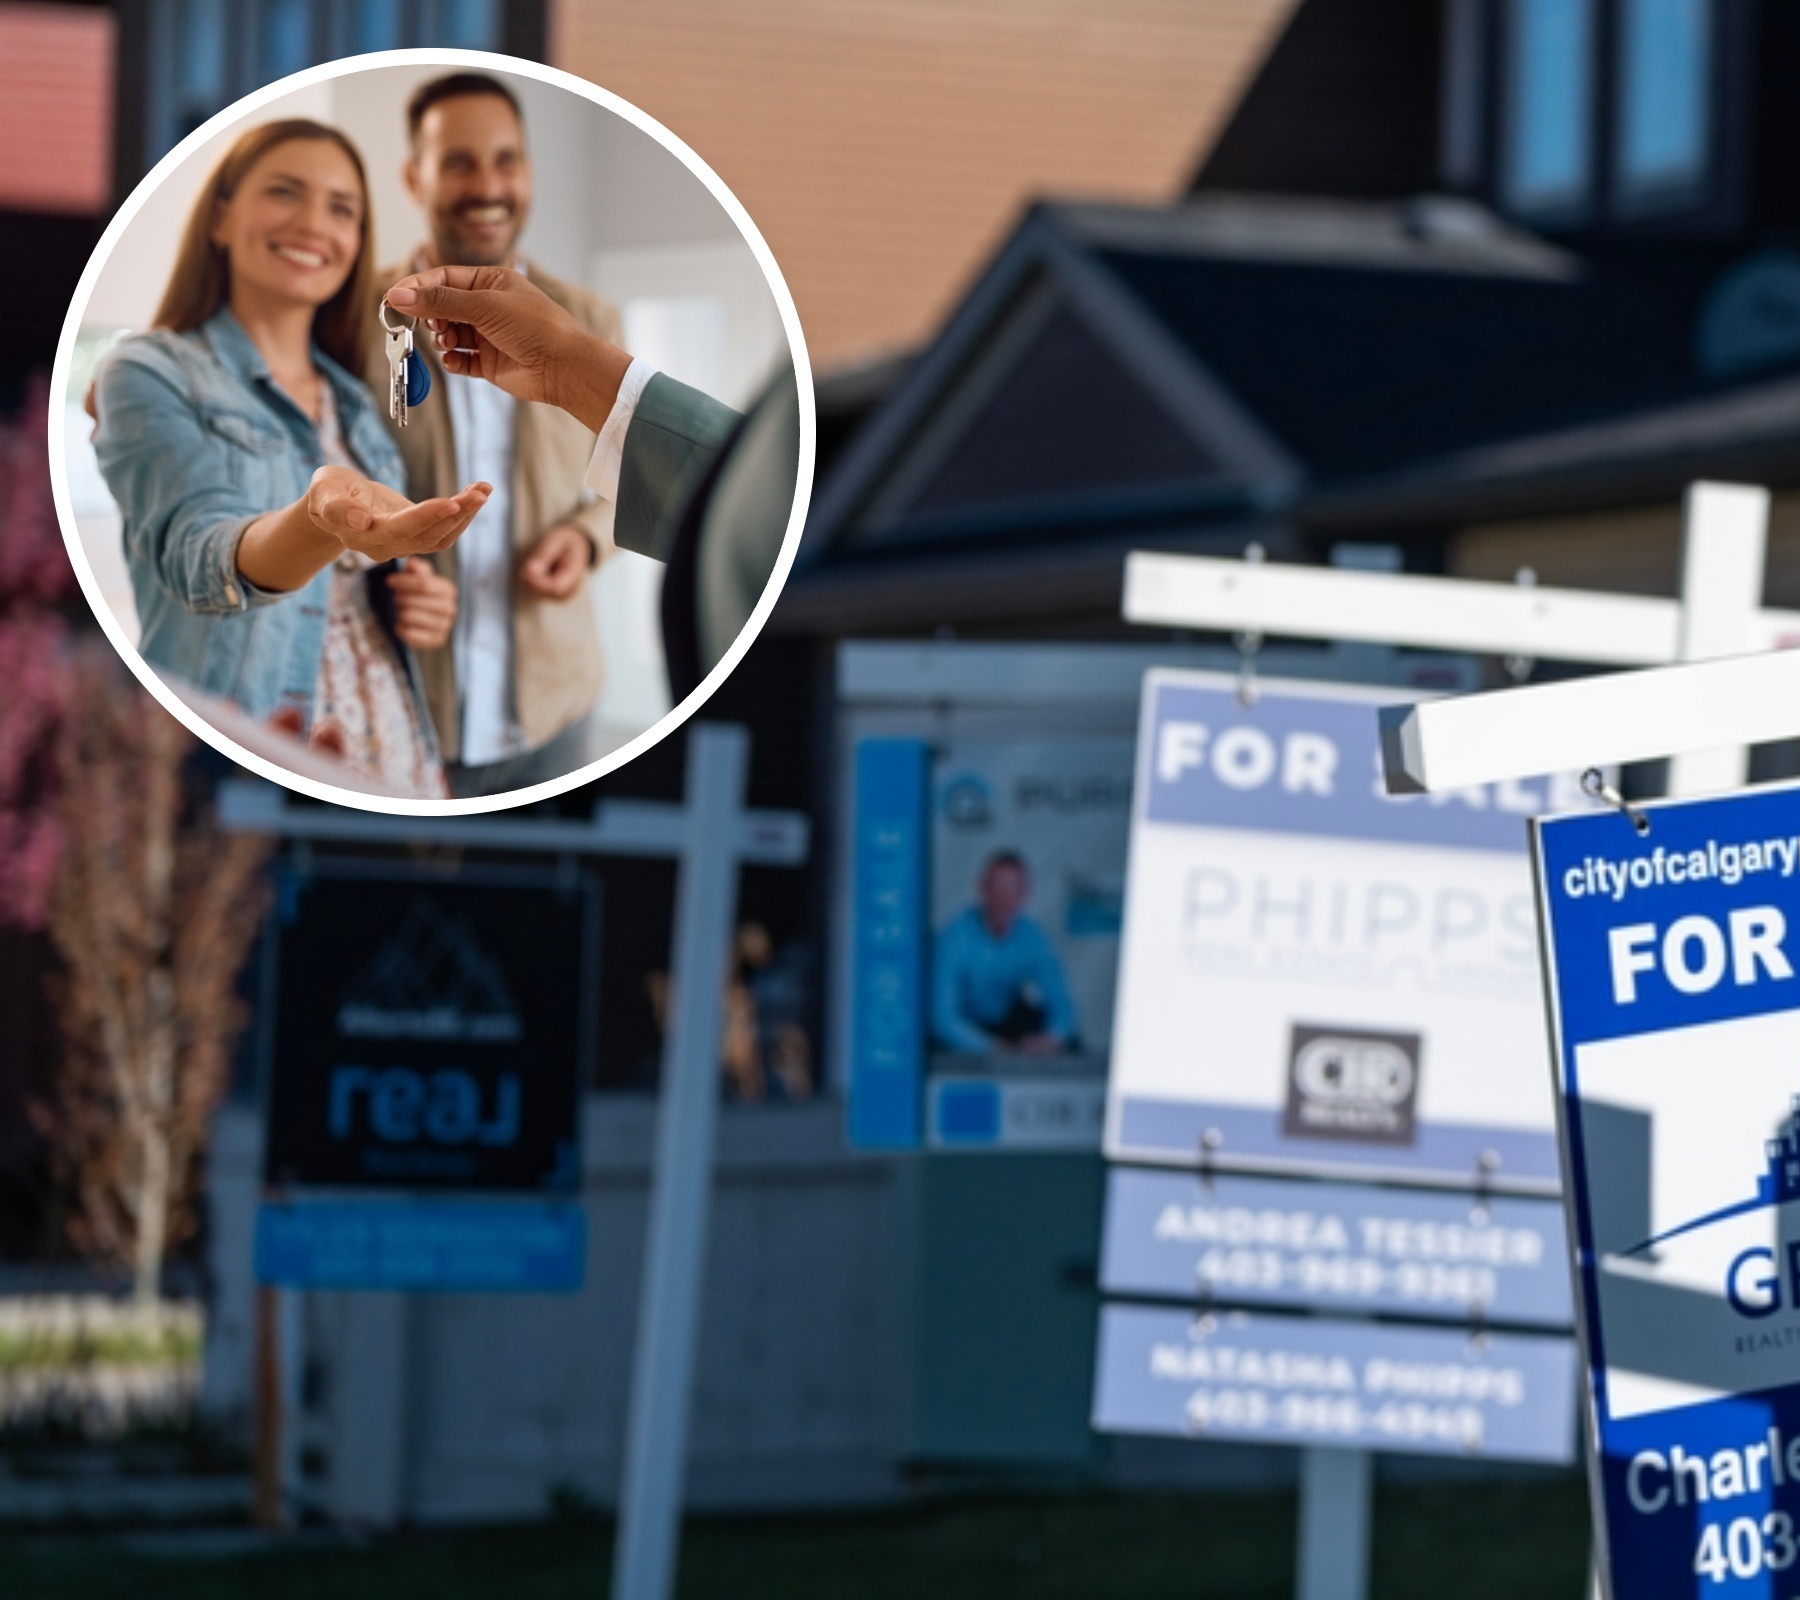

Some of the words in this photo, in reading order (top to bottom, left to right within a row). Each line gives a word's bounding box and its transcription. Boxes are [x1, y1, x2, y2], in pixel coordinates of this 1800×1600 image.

[1158, 720, 1338, 796] FOR
[1182, 864, 1534, 964] PHIPPS
[1609, 905, 1794, 1003] FOR
[1154, 1204, 1348, 1250] ANDREA
[1358, 1217, 1545, 1268] TESSIER
[1150, 1344, 1354, 1391] NATASHA
[1364, 1358, 1523, 1407] PHIPPS
